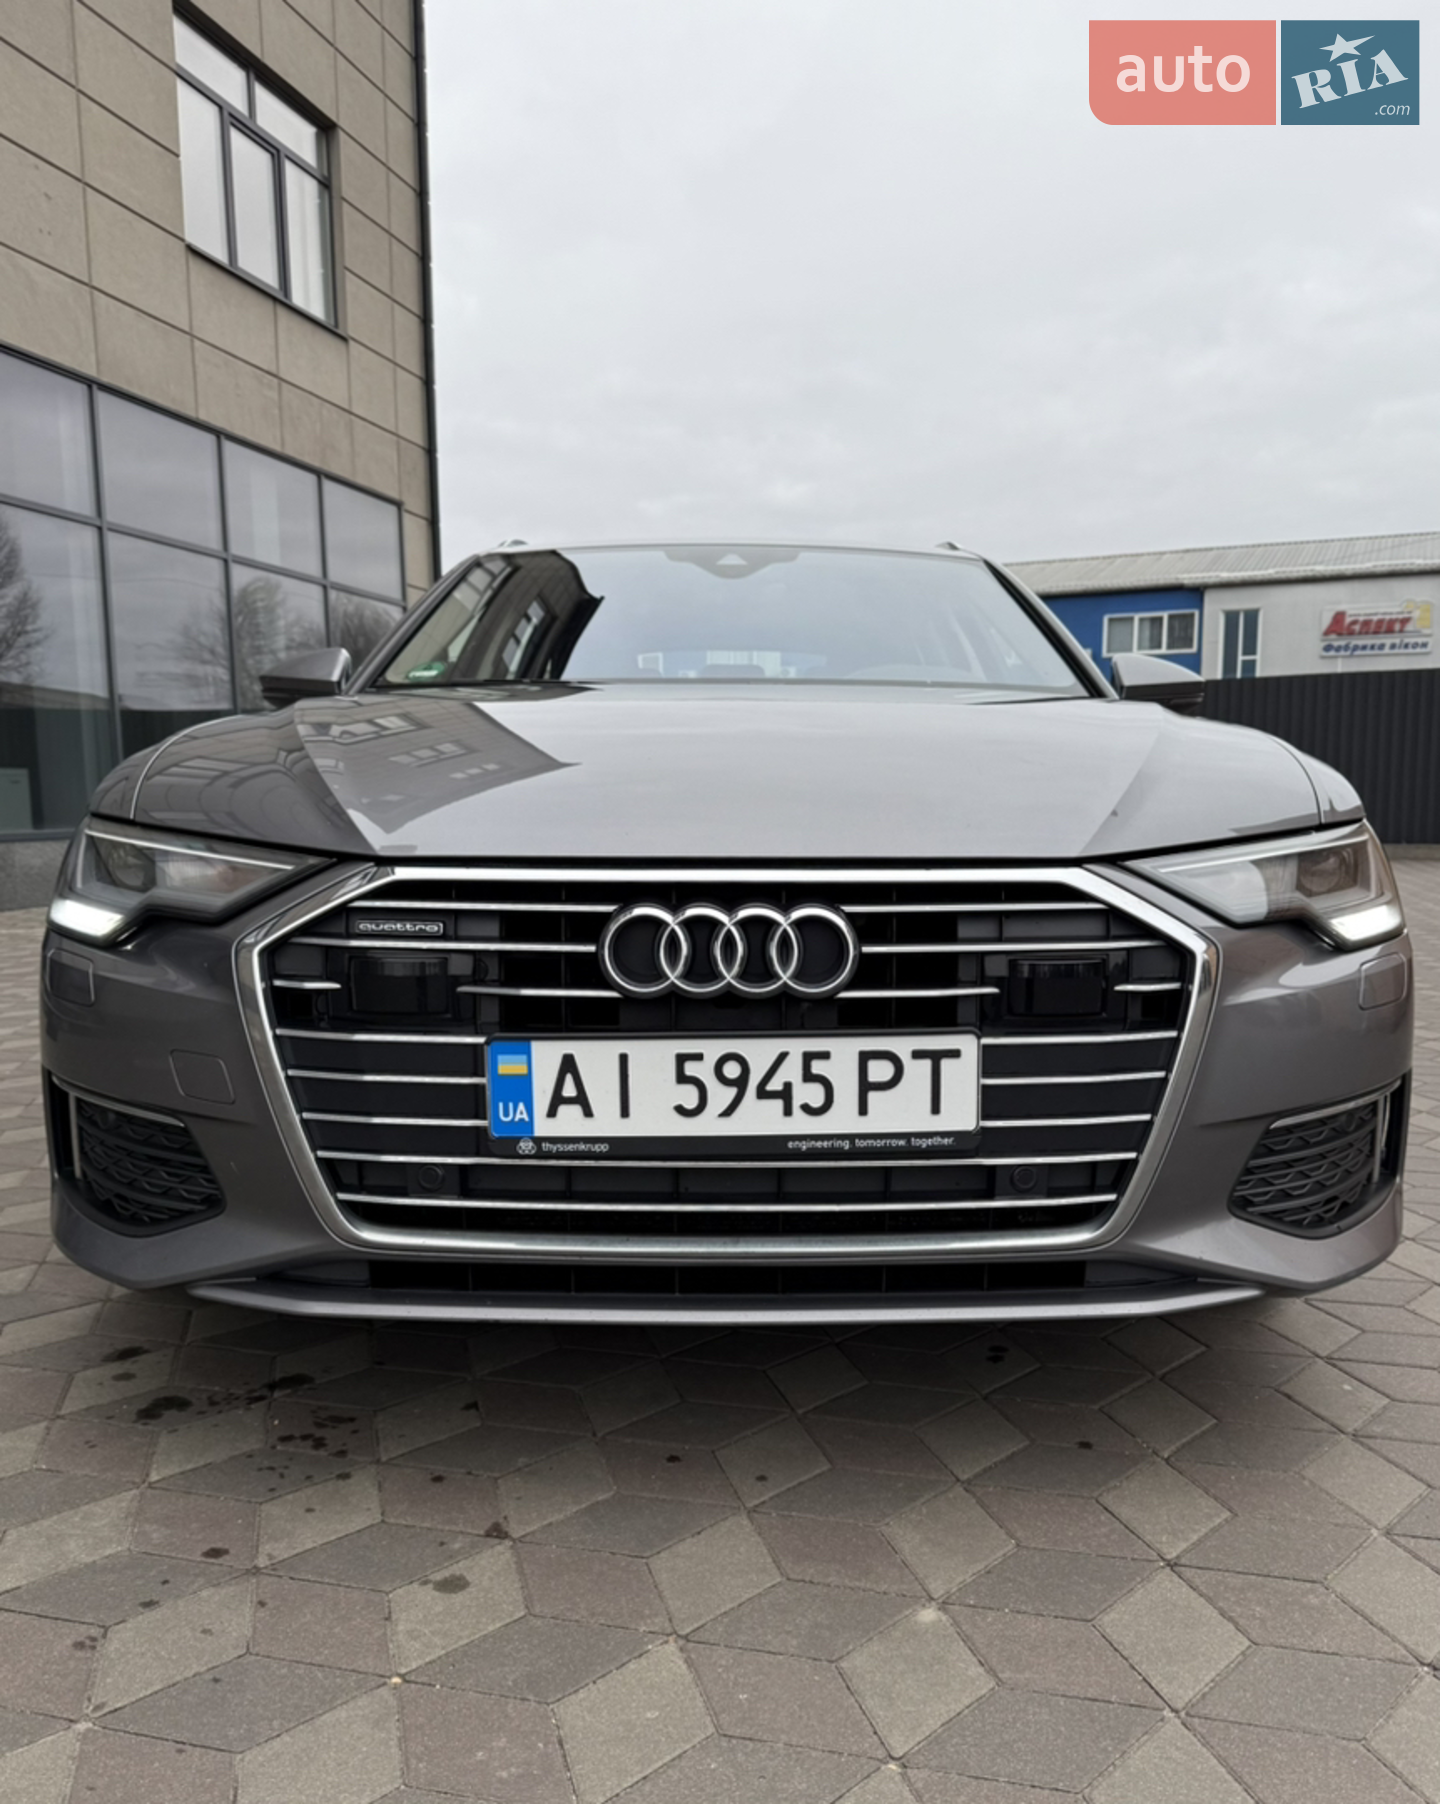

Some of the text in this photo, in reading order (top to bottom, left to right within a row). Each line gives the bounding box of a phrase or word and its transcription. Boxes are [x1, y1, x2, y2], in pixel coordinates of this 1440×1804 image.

[1322, 639, 1429, 655] Фабрика вікон
[358, 922, 439, 933] quattro
[545, 1048, 962, 1119] AI 5945 PT
[498, 1102, 530, 1122] UA
[541, 1141, 610, 1154] thyssenkrupp
